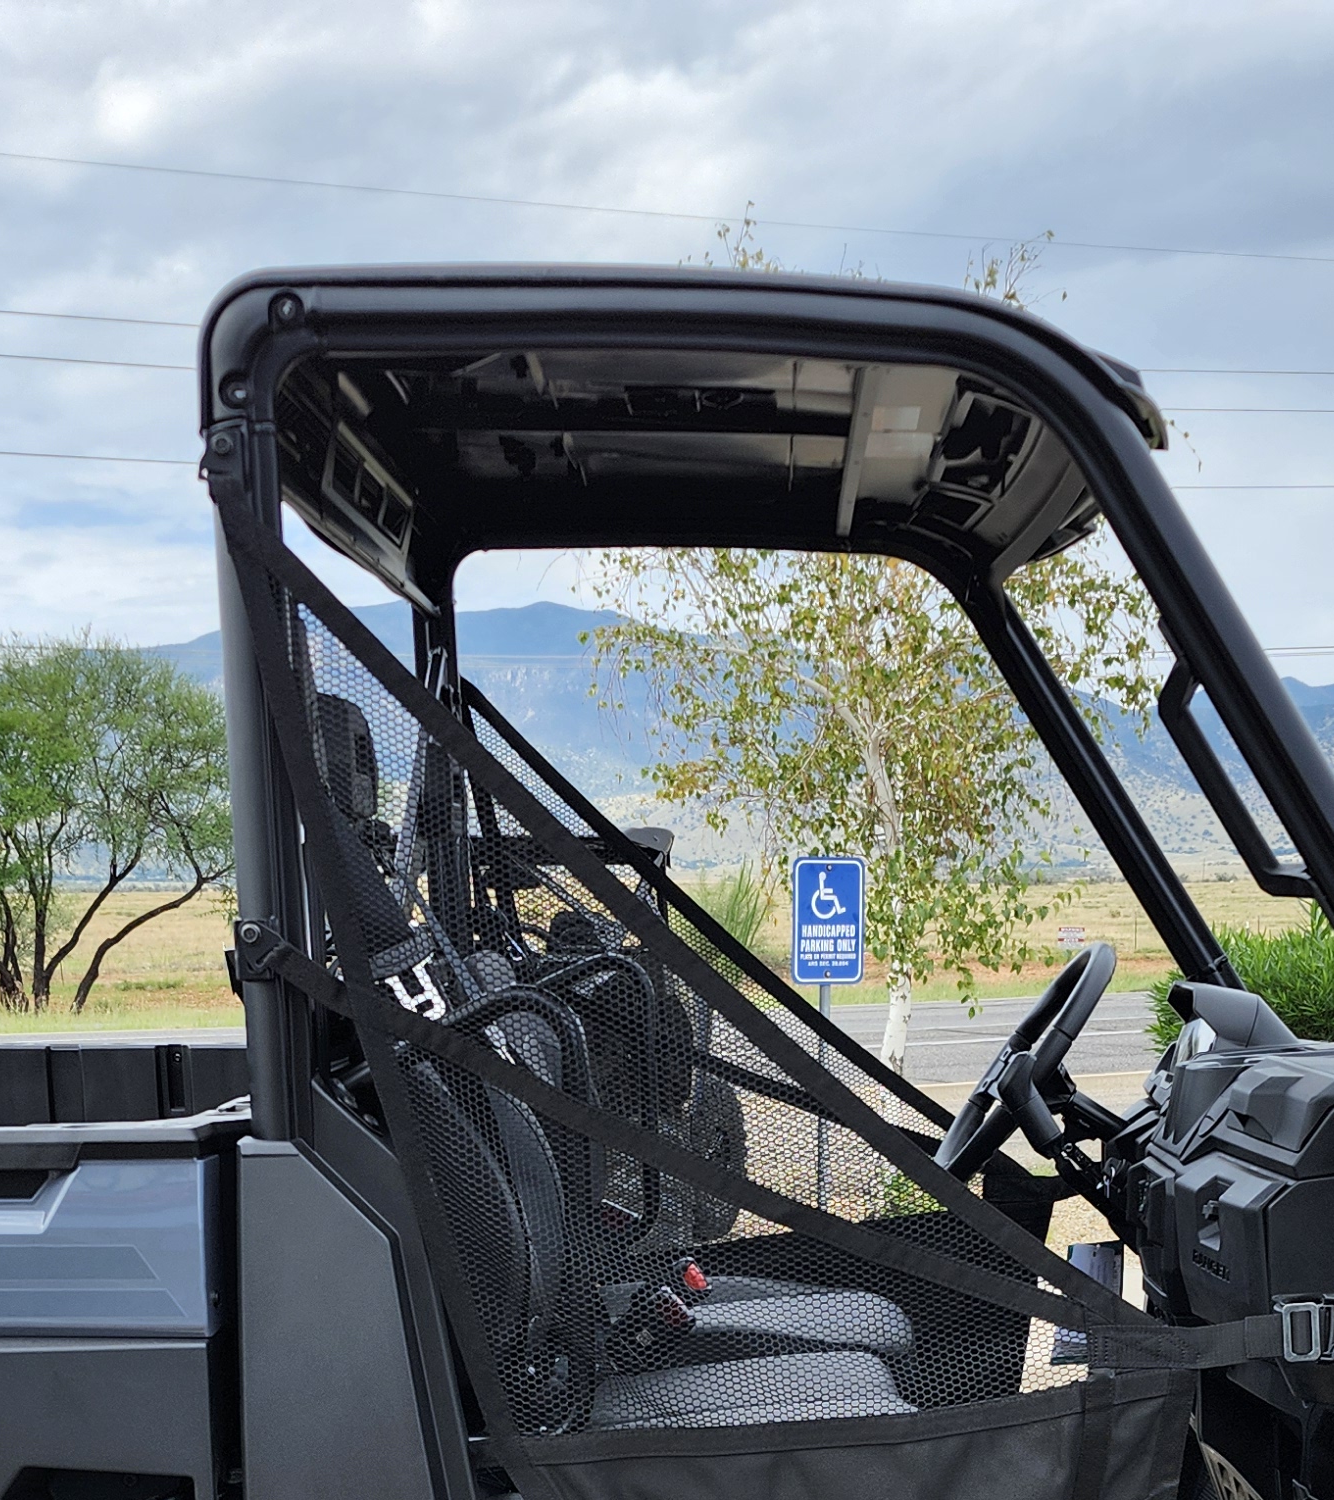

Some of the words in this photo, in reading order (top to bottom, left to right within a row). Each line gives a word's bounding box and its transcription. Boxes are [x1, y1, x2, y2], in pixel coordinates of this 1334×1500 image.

[801, 924, 856, 938] HANDICAPPED
[800, 938, 835, 952] PARKING
[836, 938, 857, 952] ONLY
